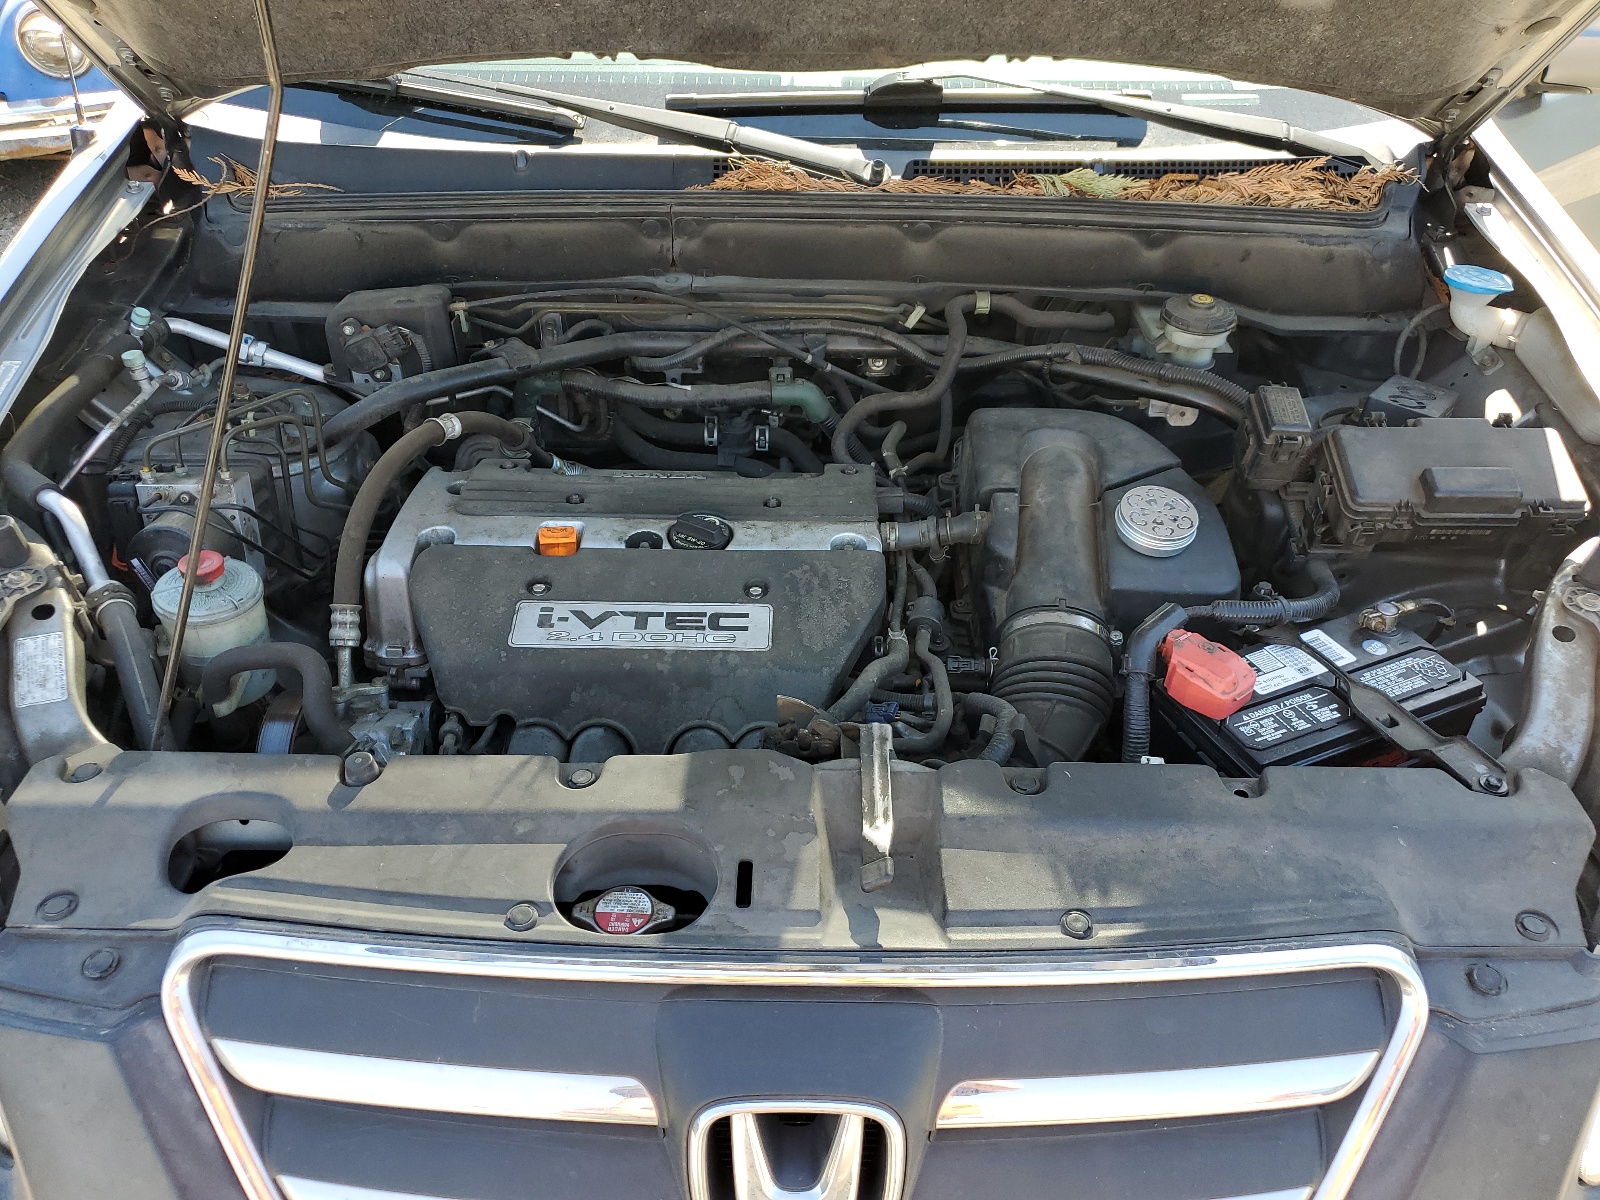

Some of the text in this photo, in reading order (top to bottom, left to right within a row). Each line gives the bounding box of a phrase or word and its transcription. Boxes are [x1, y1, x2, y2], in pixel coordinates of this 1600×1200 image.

[536, 606, 750, 631] i-VTEC
[546, 631, 737, 644] 2.4 DOHC
[1248, 703, 1280, 719] DANGER
[1284, 692, 1313, 707] POISON
